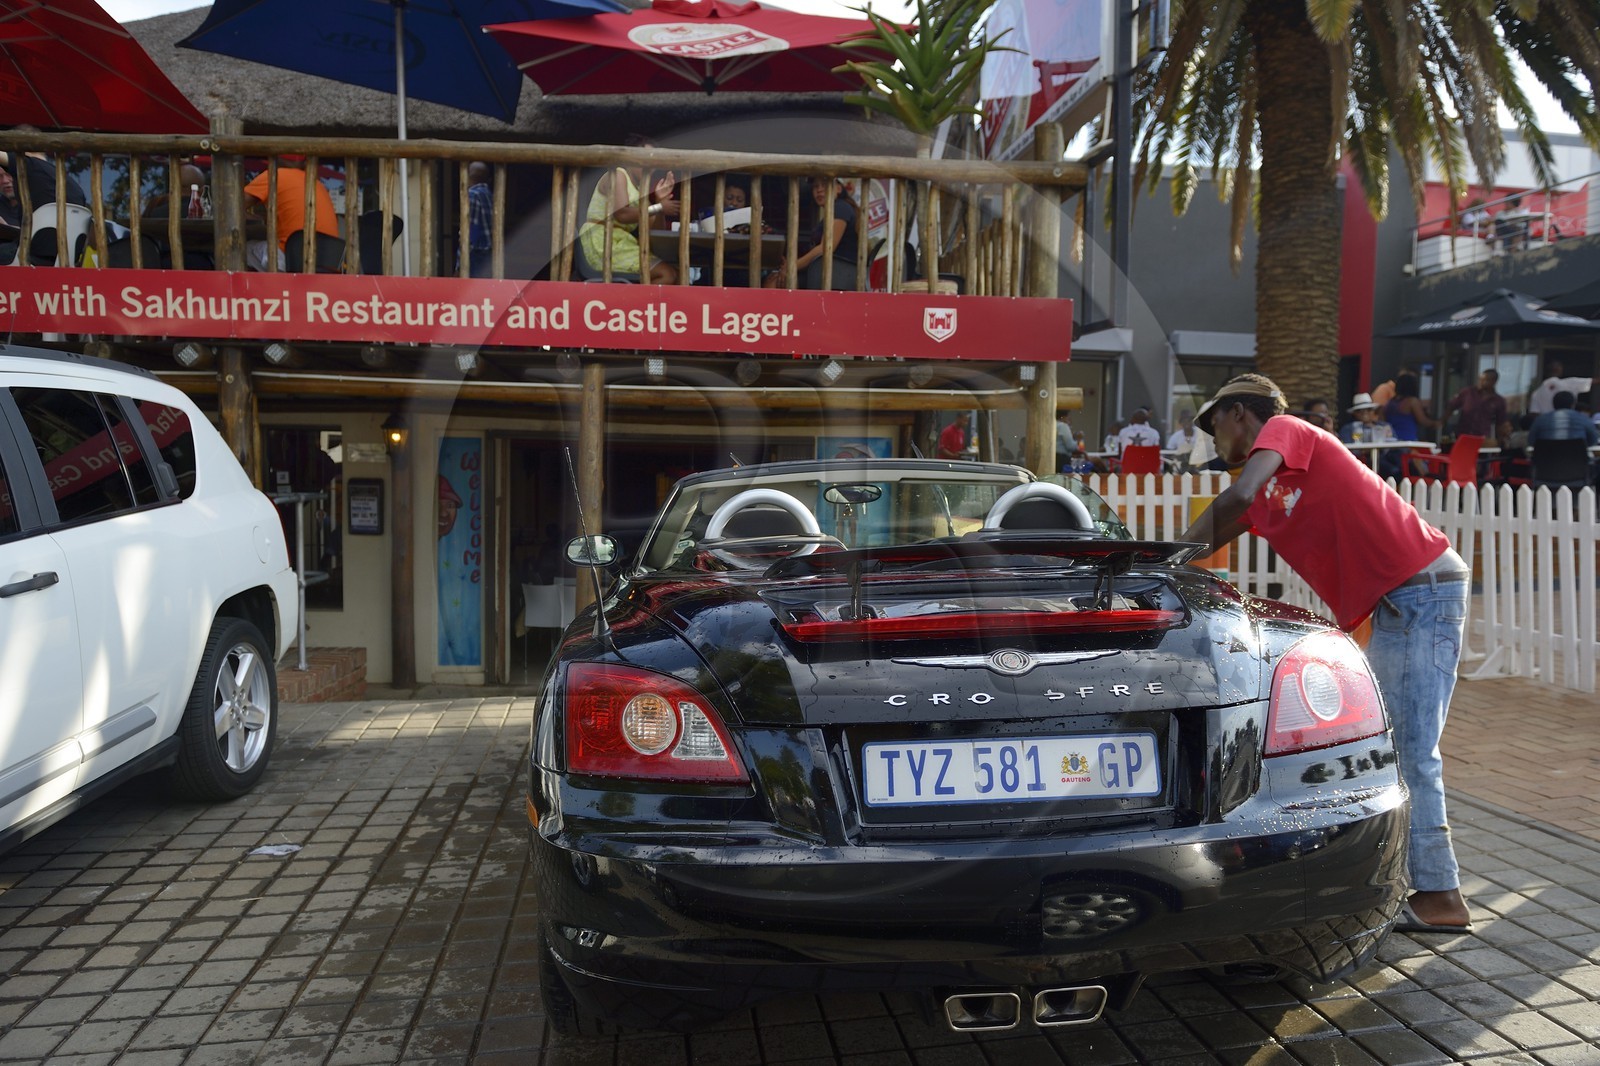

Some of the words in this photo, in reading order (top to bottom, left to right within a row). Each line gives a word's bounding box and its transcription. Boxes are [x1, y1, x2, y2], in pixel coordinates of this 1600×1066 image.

[660, 33, 756, 55] CASTLE
[34, 285, 107, 317] with
[122, 287, 291, 322] Sakhumzi
[306, 292, 495, 329] Restaurant
[506, 300, 570, 330] and
[583, 300, 688, 334] Castle
[702, 304, 801, 343] Lager.
[880, 748, 955, 797] TYZ
[973, 745, 1047, 793] 581
[1097, 741, 1143, 789] GP
[1061, 776, 1091, 784] GAUTENG
